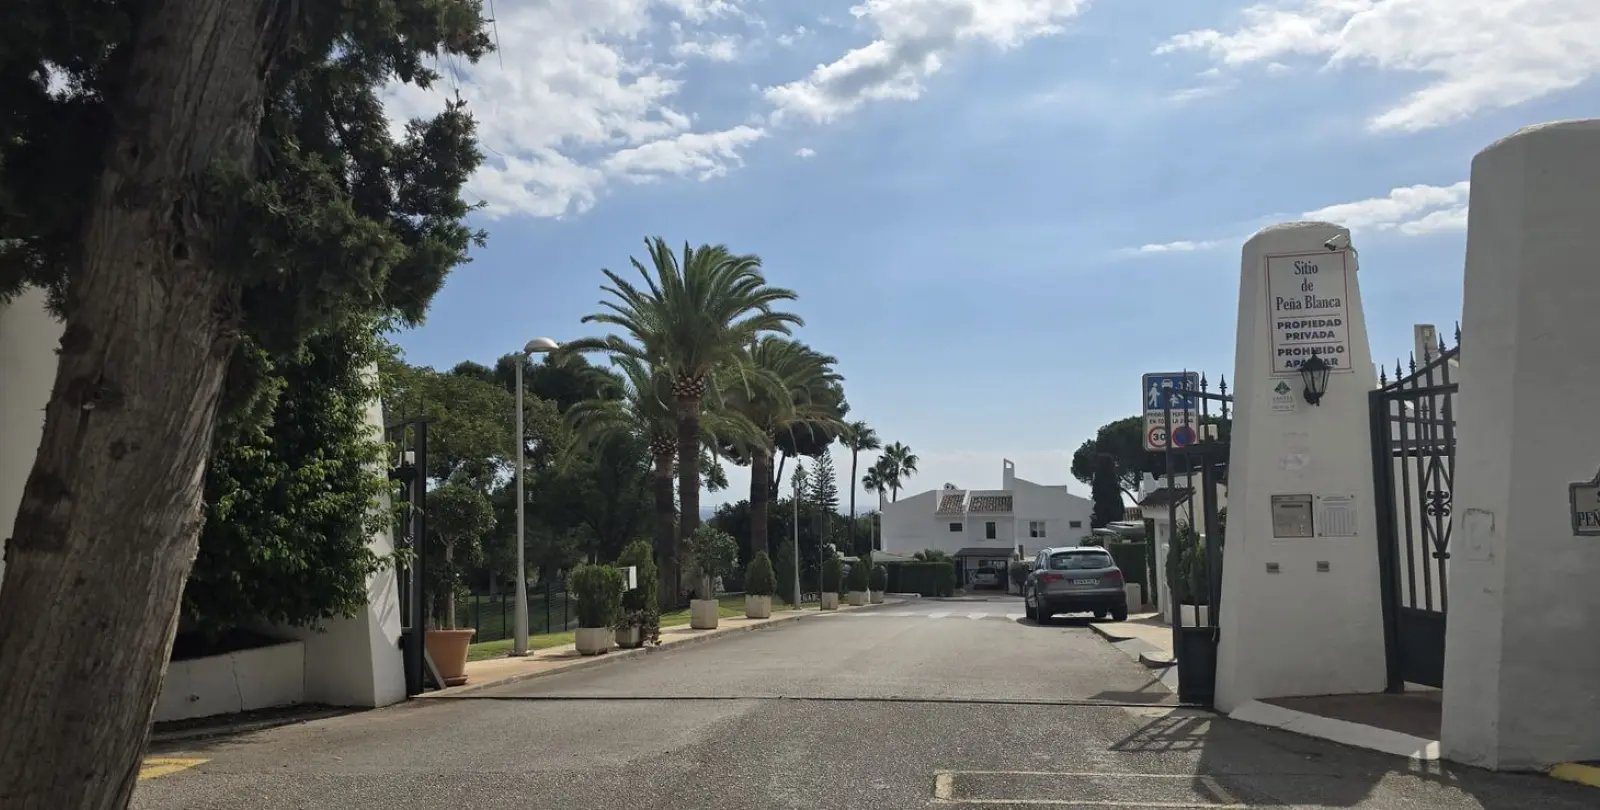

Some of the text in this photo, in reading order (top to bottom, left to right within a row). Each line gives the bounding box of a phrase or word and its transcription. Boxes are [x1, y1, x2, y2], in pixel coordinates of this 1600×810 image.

[1294, 260, 1318, 275] Sitio
[1301, 278, 1314, 292] de
[1276, 295, 1341, 311] Peña Blanca
[1277, 318, 1342, 330] PROPIEDAD
[1285, 330, 1335, 341] PRIVADA
